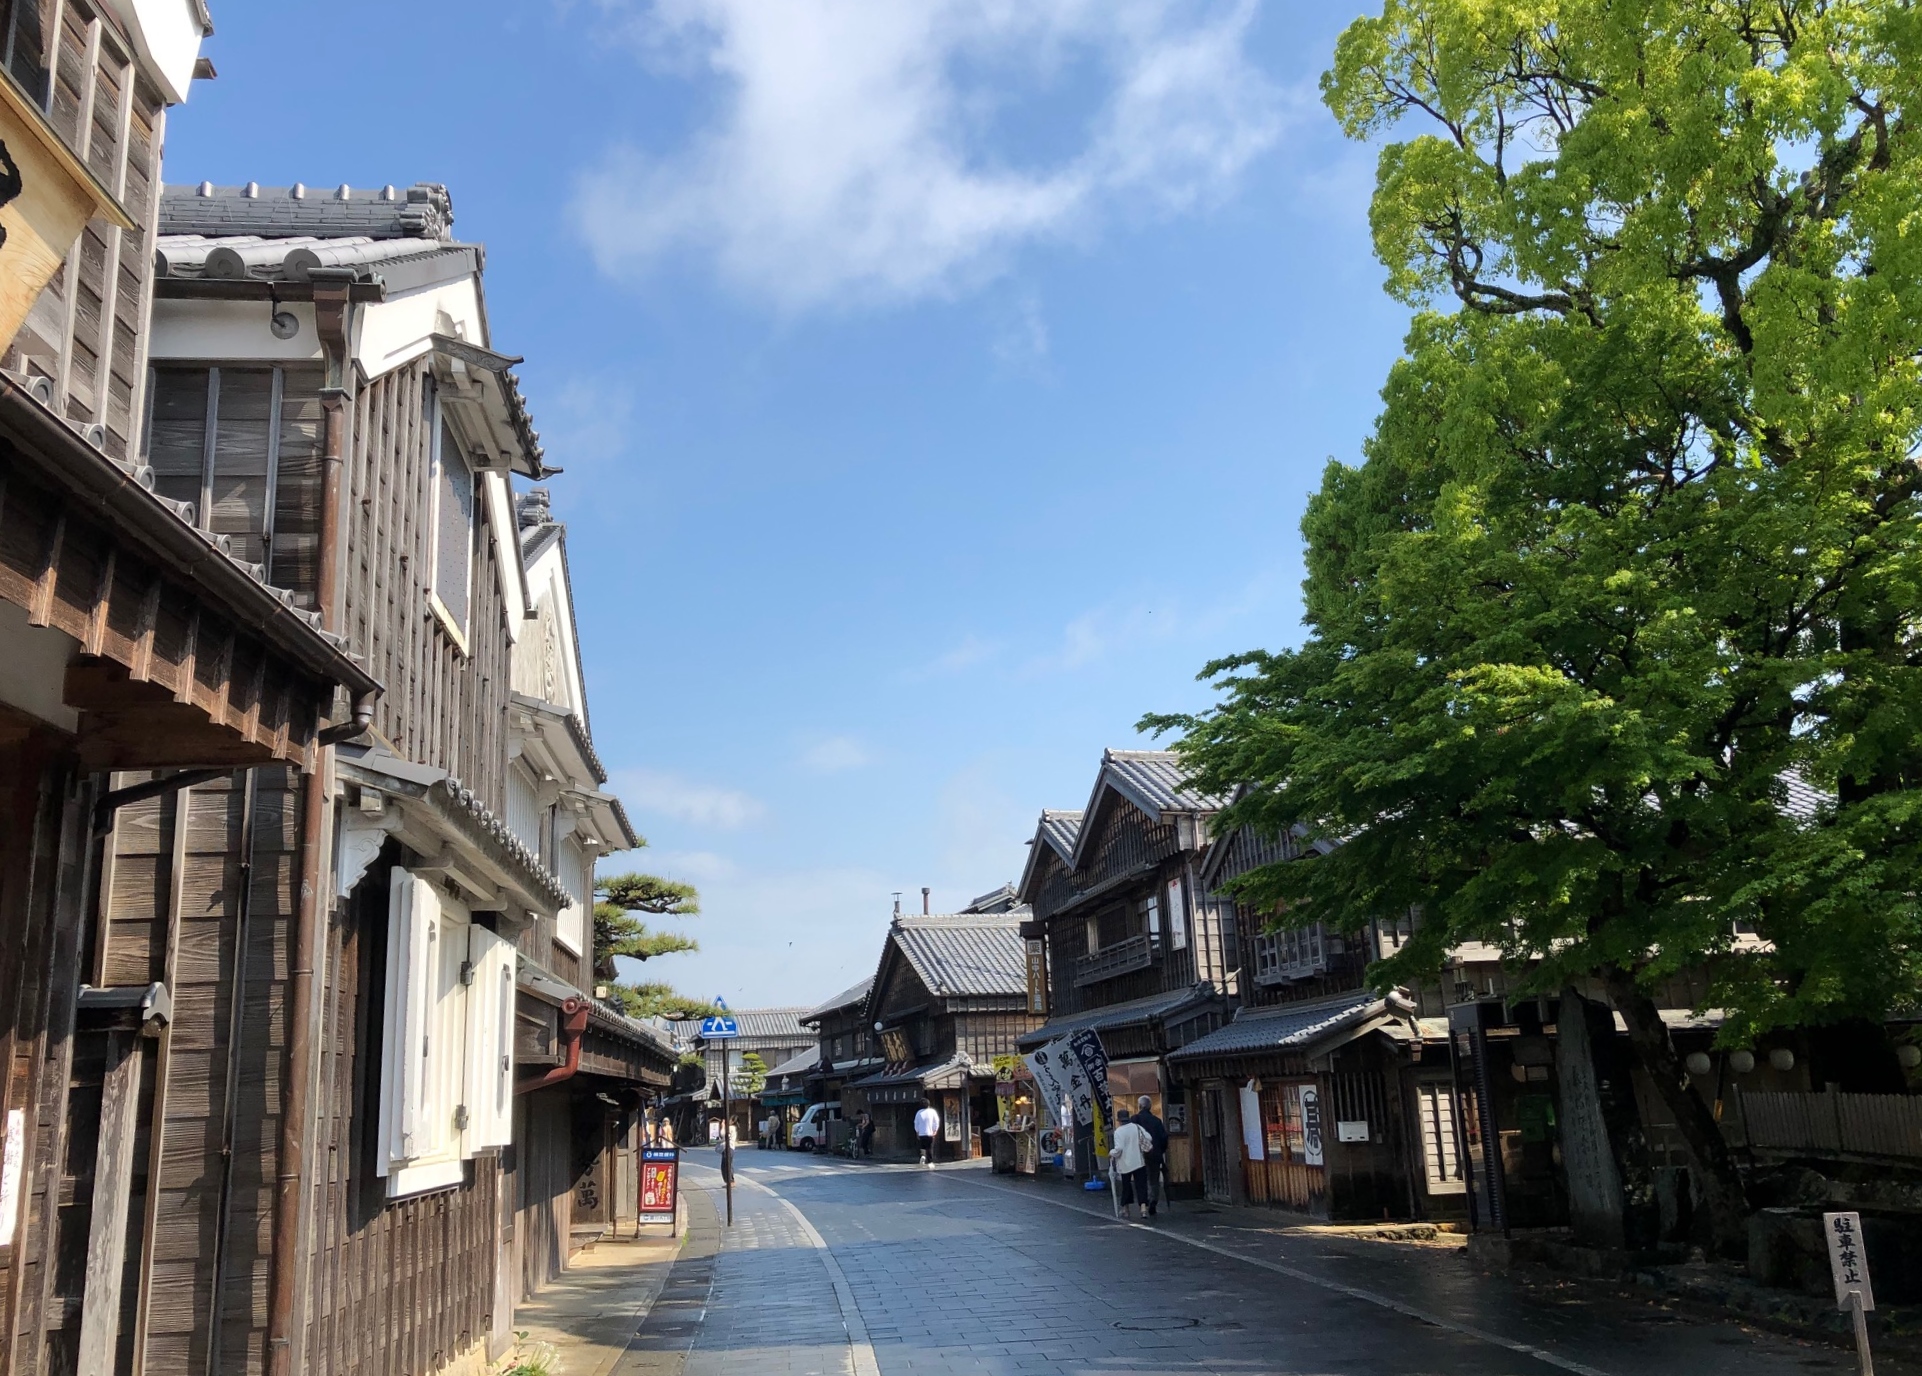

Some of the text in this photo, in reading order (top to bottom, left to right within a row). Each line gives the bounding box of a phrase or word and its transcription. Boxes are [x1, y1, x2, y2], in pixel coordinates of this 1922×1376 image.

[1058, 1050, 1091, 1110] 萬金丹
[1833, 1217, 1862, 1284] 駐車禁止
